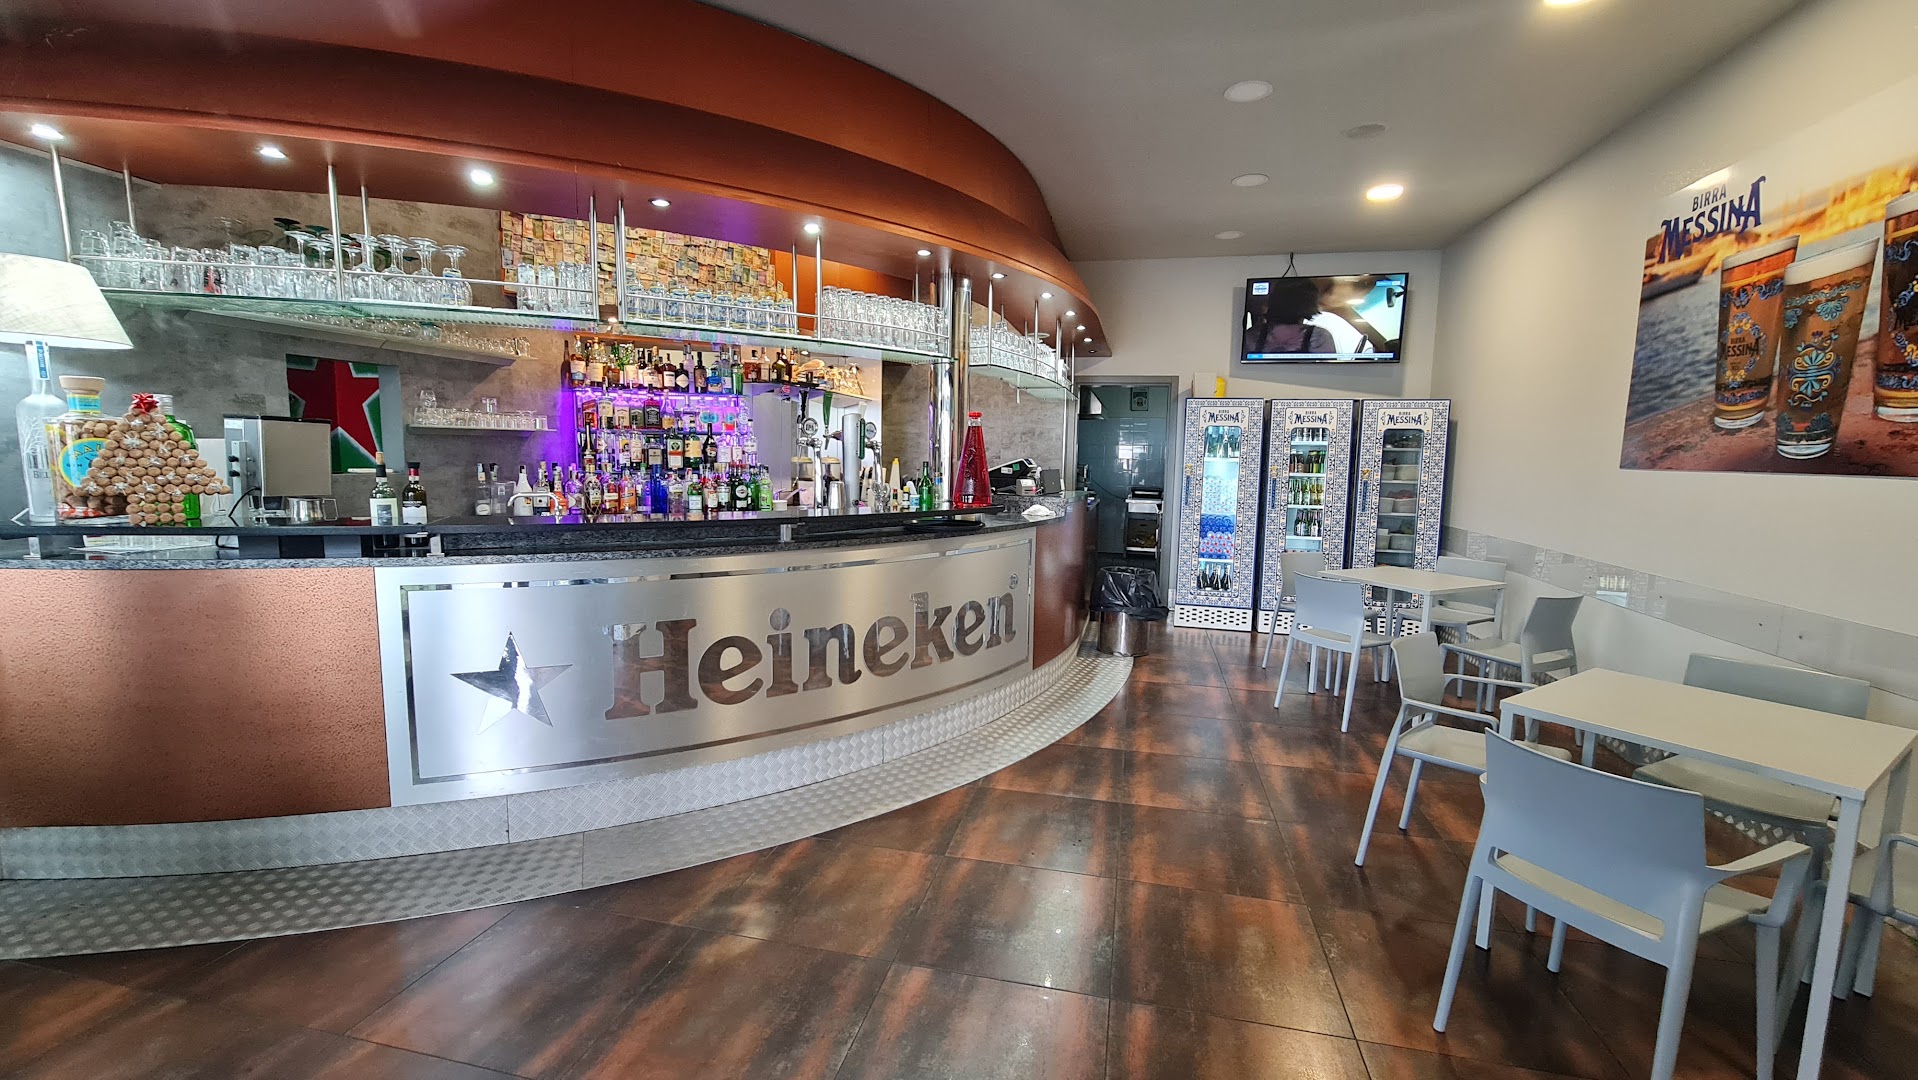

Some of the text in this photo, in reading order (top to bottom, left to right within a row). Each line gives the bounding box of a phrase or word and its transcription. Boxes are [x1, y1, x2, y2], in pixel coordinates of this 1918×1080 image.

[1692, 184, 1727, 212] BIRRA
[1657, 176, 1766, 264] MESSINA
[1207, 411, 1240, 423] MESSINA
[1294, 412, 1328, 425] MESSINA
[1386, 414, 1422, 426] MESSINA
[602, 591, 1017, 721] Heineken
